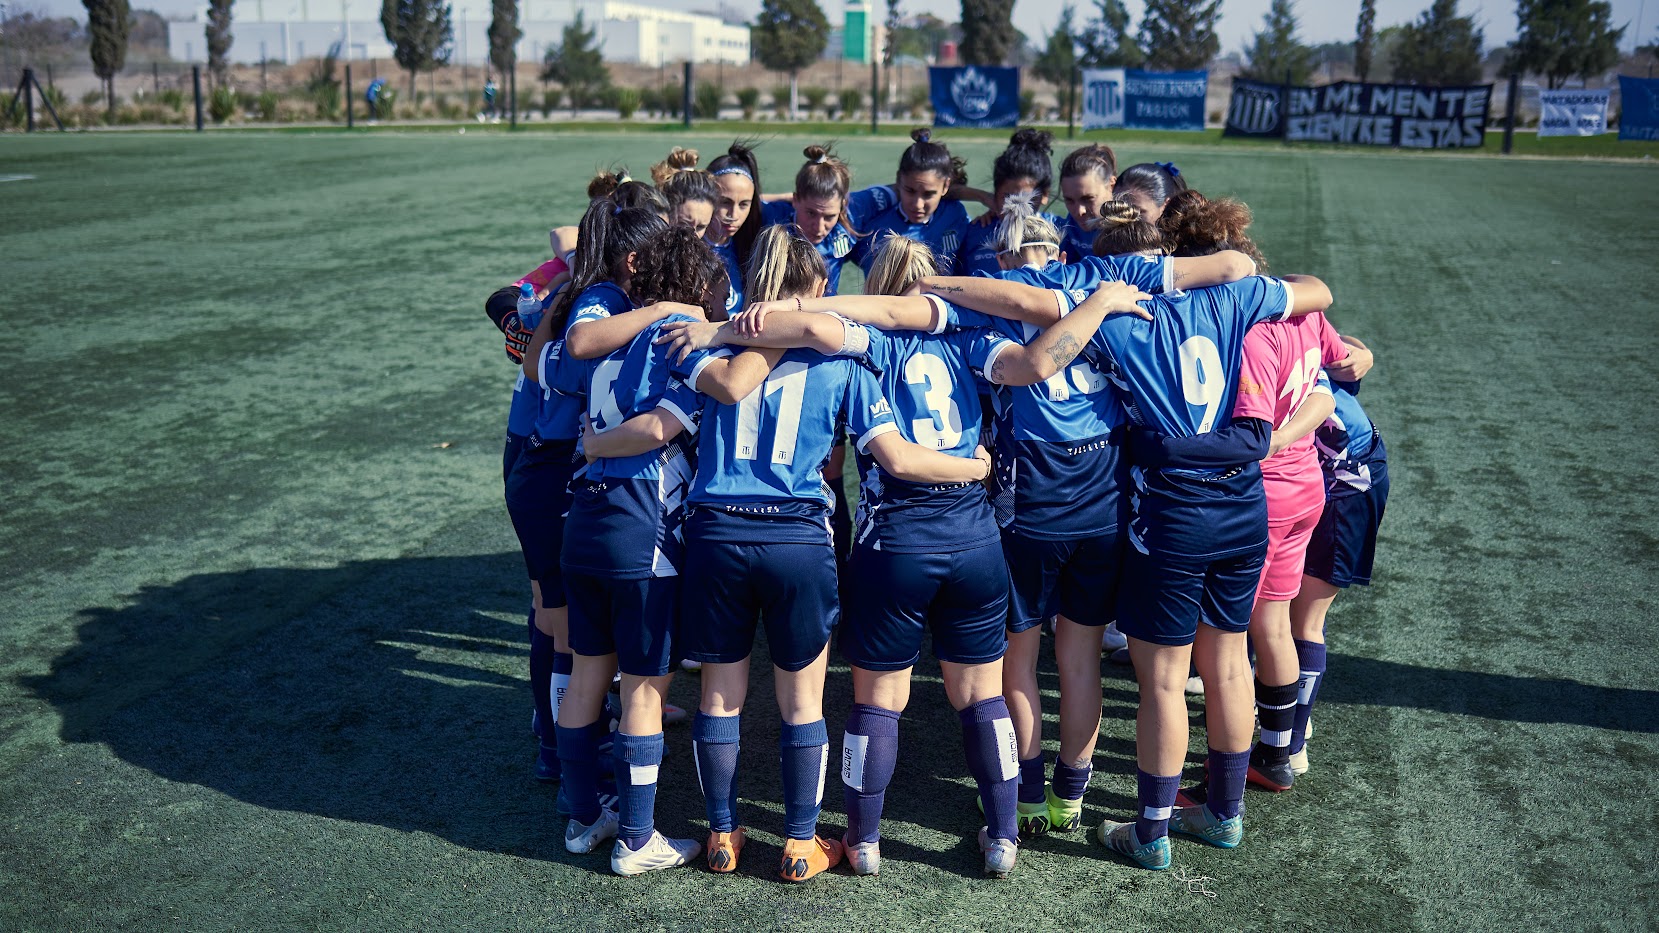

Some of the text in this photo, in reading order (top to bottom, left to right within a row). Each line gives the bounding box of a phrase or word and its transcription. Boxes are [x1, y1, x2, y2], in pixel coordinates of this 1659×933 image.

[1287, 114, 1393, 144] SIEMPRE
[1288, 85, 1489, 117] EN MI MENTE
[590, 360, 625, 435] 5
[735, 361, 809, 466] 11
[905, 352, 963, 450] 3
[1179, 335, 1226, 436] 9
